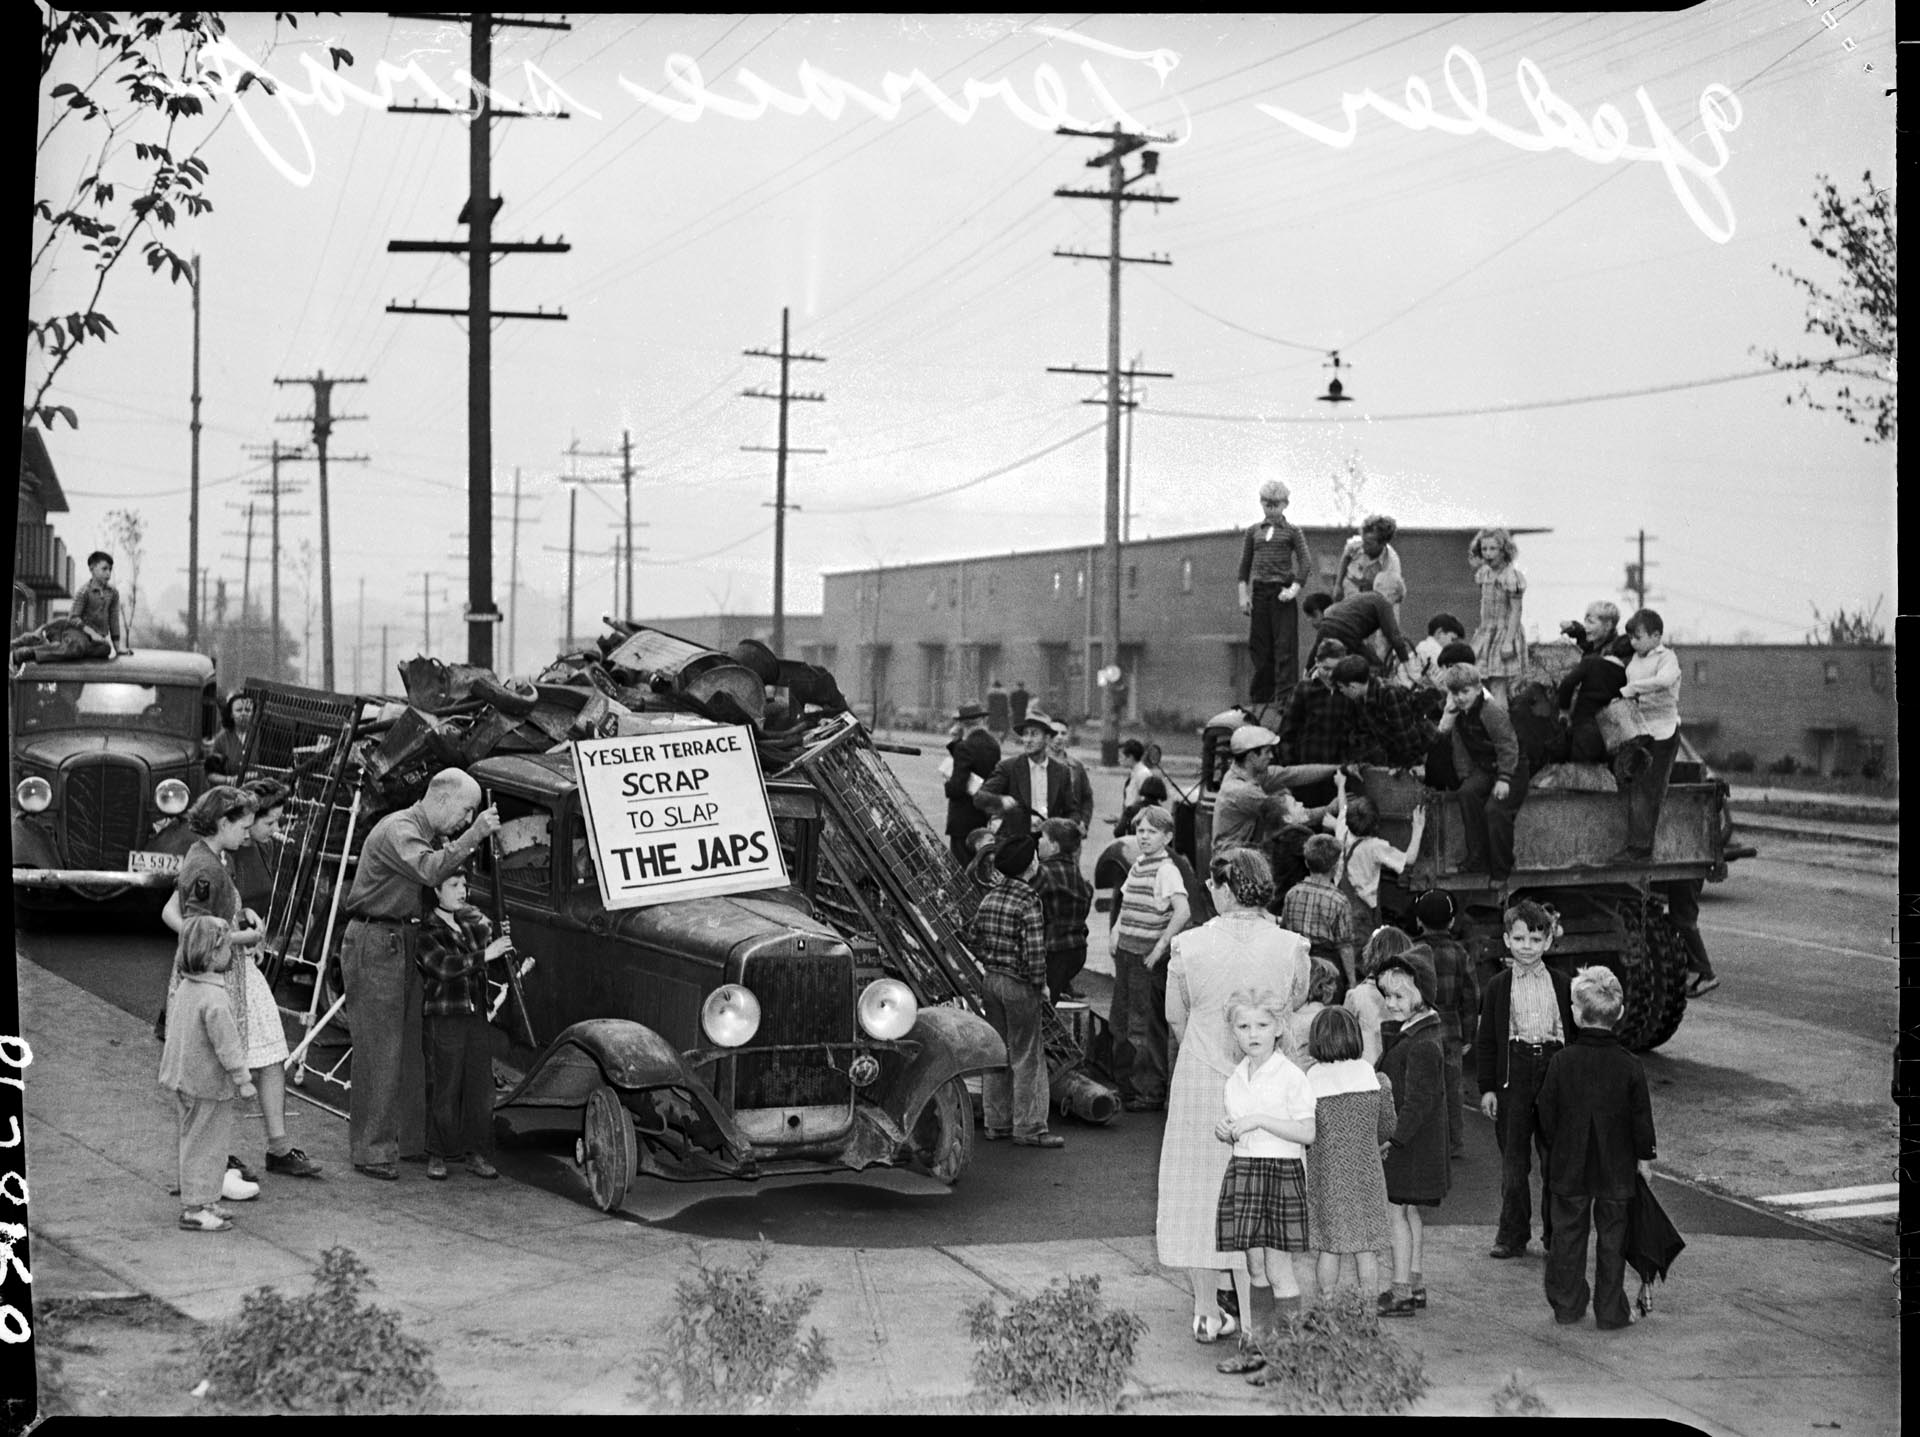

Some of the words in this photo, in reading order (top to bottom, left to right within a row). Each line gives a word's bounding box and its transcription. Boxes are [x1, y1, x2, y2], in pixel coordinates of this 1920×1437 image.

[584, 745, 656, 767] YESLER
[660, 736, 742, 759] TERRACE
[622, 768, 709, 797] SCRAP
[627, 810, 654, 829] TO
[664, 803, 719, 827] SLAP
[611, 843, 682, 880] THE
[690, 831, 769, 871] JAPS
